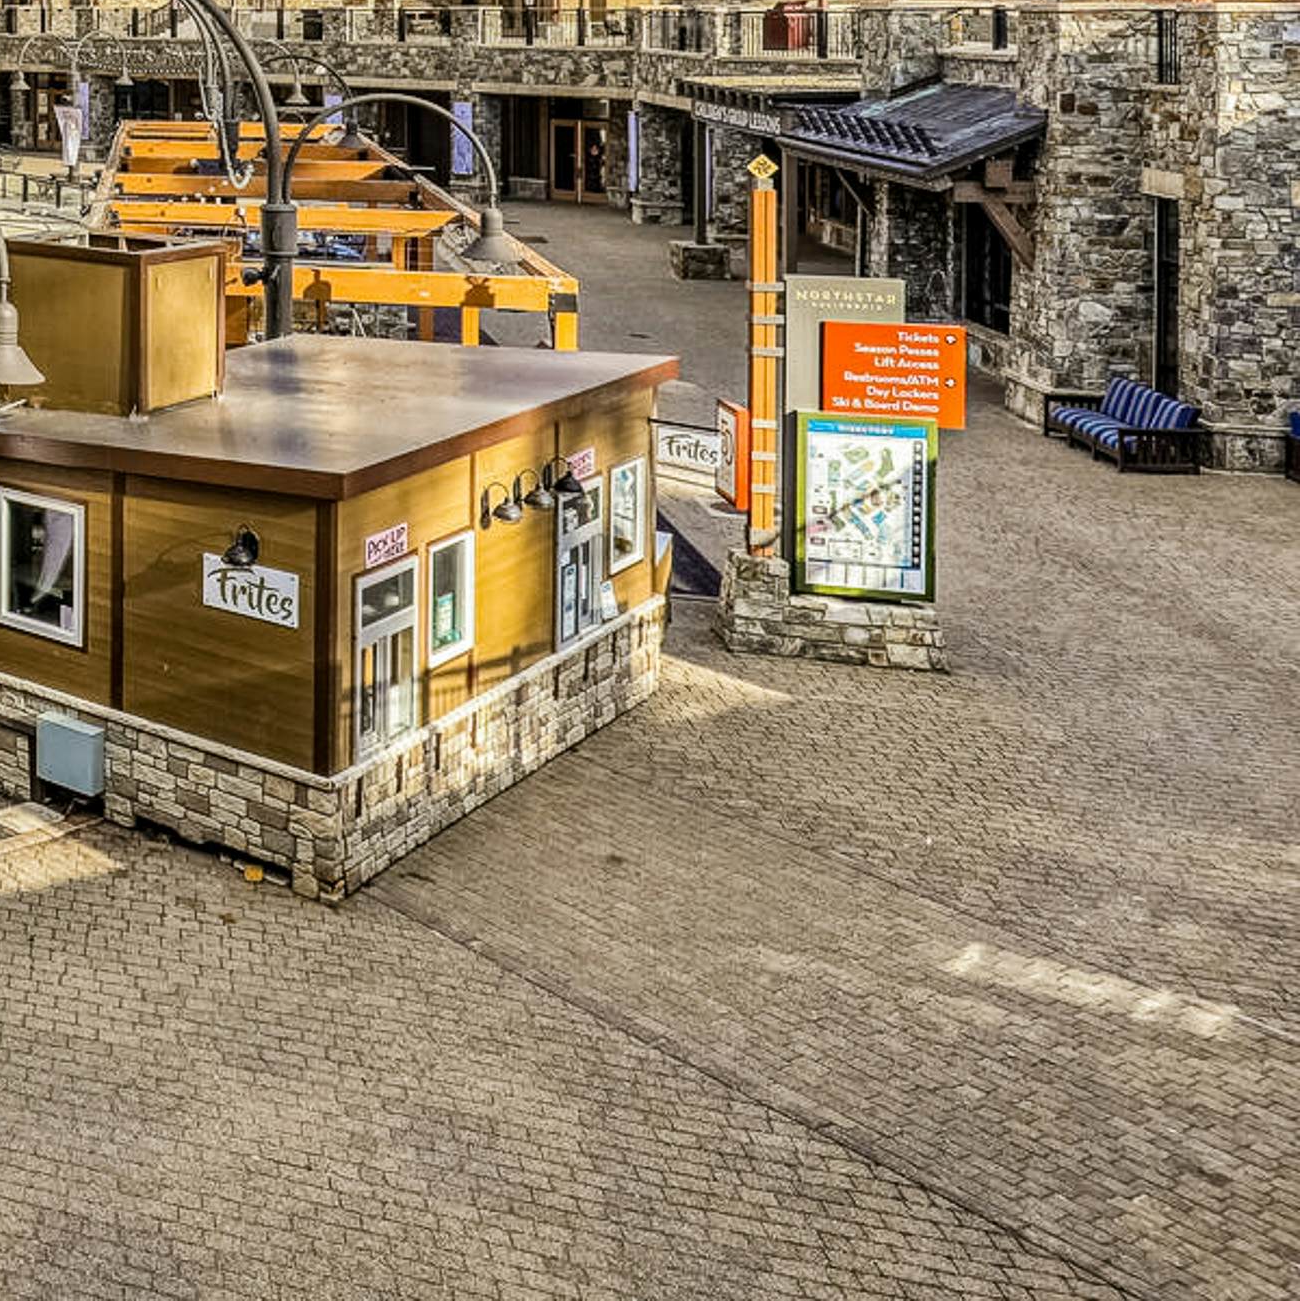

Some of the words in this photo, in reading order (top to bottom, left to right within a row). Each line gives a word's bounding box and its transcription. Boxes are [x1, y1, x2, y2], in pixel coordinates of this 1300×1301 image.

[796, 290, 896, 305] NORTHSTAR
[898, 332, 939, 343] Tickets
[854, 342, 897, 355] Season
[899, 345, 939, 357] Passes
[874, 356, 895, 368] Lift
[897, 358, 939, 370] Access
[844, 371, 939, 386] Restrooms/ATM
[866, 386, 890, 398] Day
[892, 387, 939, 400] Lockers
[832, 397, 849, 407] Ski
[852, 399, 862, 408] &
[864, 399, 899, 411] Board
[902, 401, 939, 413] Demo
[661, 434, 718, 465] Frites
[208, 567, 294, 621] Frites
